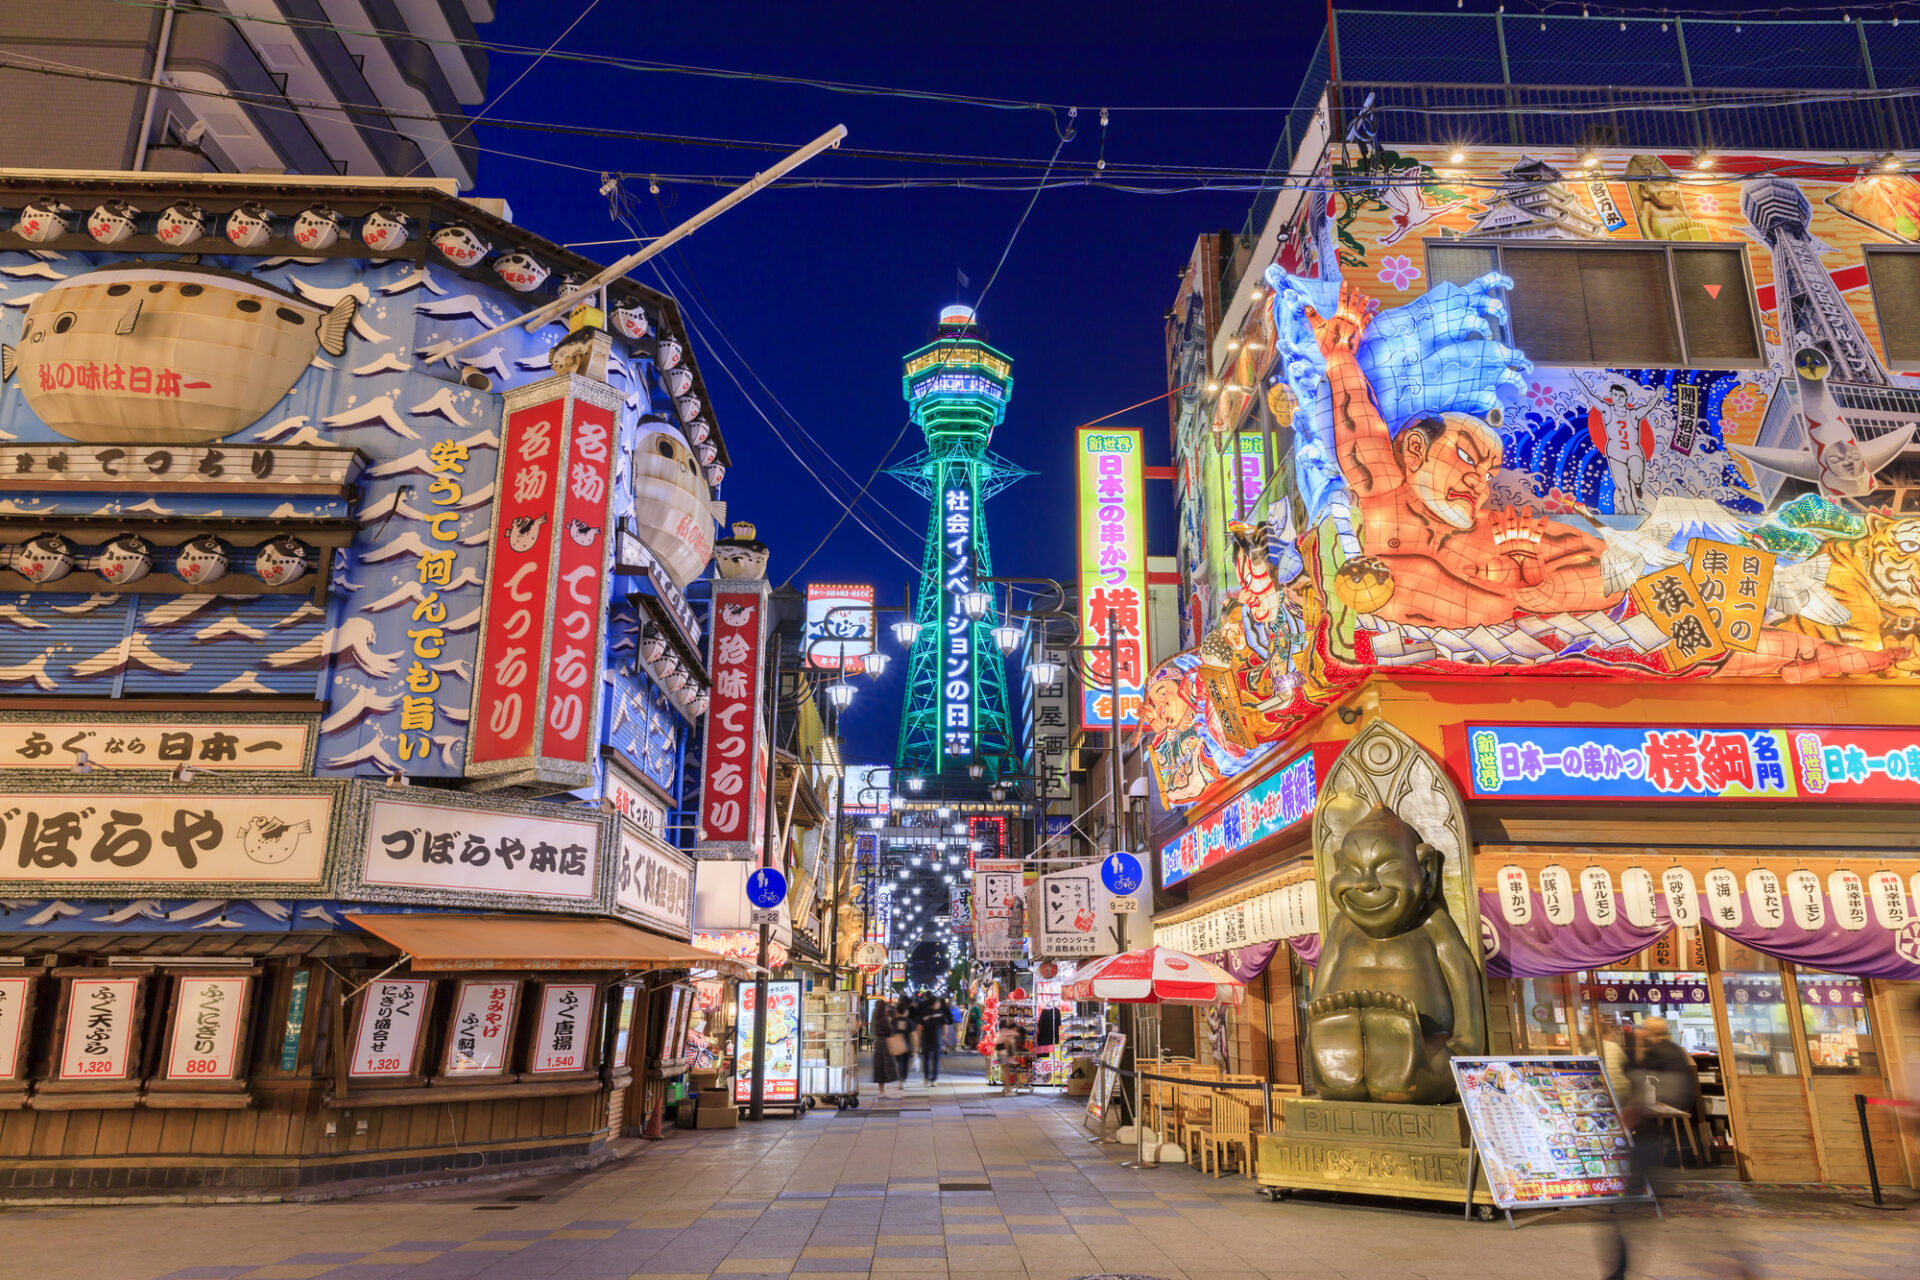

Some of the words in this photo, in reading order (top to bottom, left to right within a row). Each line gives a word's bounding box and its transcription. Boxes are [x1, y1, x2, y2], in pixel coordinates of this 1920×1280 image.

[39, 361, 213, 398] 私の味は日本一
[1615, 420, 1631, 451] グリコ
[1674, 385, 1698, 450] 開運招福
[514, 420, 551, 504] 名物
[570, 420, 608, 504] 名物
[1087, 435, 1132, 452] 新世界
[1097, 454, 1127, 586] 日本一の串かつ
[398, 438, 470, 761] 安うて何んでも旨い
[1697, 549, 1730, 631] 串かつ
[1729, 555, 1761, 641] 日本一の
[1649, 574, 1713, 659] 横綱
[820, 656, 854, 666] 年中休
[1477, 733, 1499, 789] 新世界
[1499, 744, 1644, 778] 日本一の串かつ
[1645, 731, 1755, 792] 横綱
[1752, 735, 1785, 790] 名門
[1800, 737, 1825, 791] 新世界
[381, 827, 589, 877] づぼらや本店
[1510, 881, 1526, 918] 串かつ
[1593, 879, 1610, 919] ホルモン
[1669, 881, 1688, 920] 砂ずり
[1715, 883, 1736, 921] 海老
[1763, 883, 1780, 919] ほたて
[1802, 883, 1820, 922] サーモン
[370, 984, 399, 1053] にぎり盛合せ
[395, 984, 415, 1017] ふぐ
[482, 987, 507, 1039] おみやげ
[551, 990, 579, 1051] ふぐ唐揚
[76, 1060, 113, 1074] 1,320
[185, 1059, 217, 1073] 880
[367, 1058, 400, 1071] 1,320
[546, 1056, 574, 1069] 1,540
[1304, 1107, 1437, 1140] BILLIKEN
